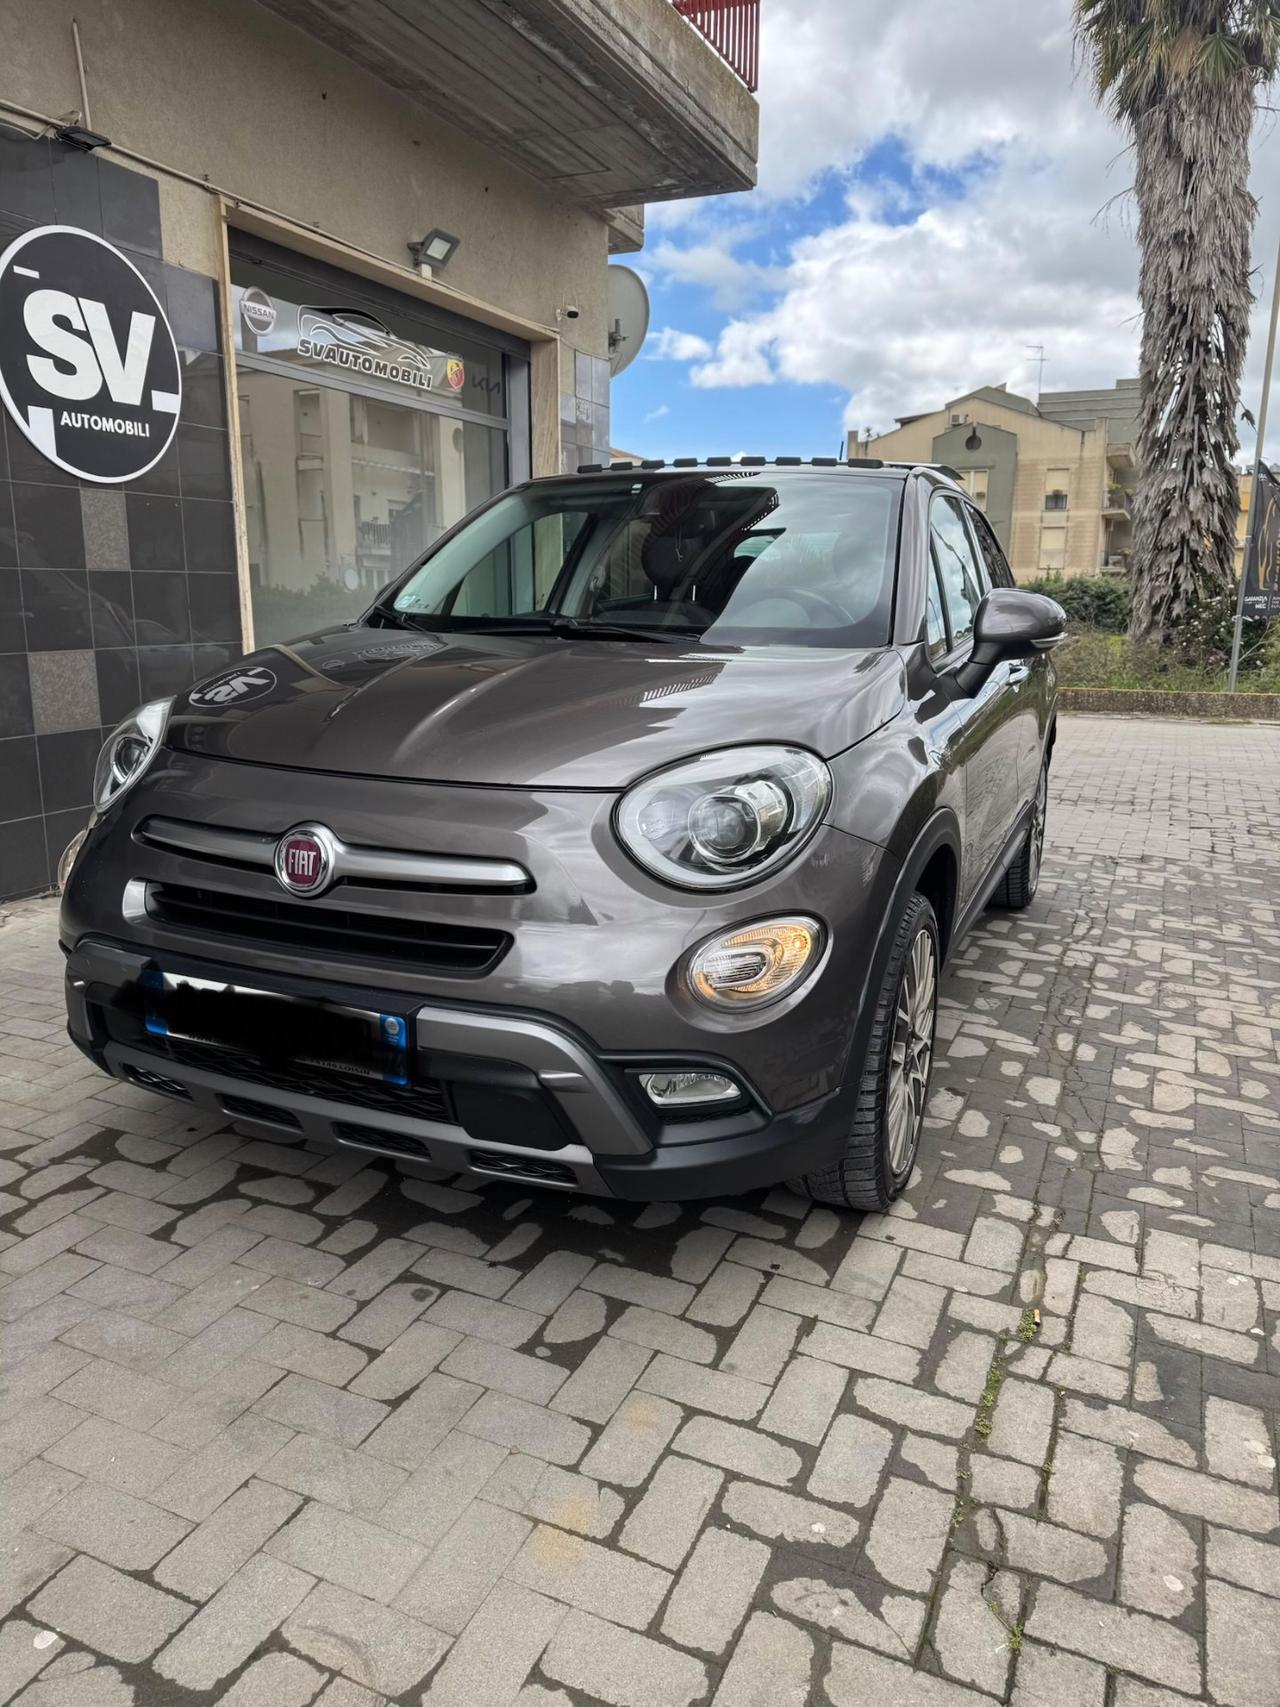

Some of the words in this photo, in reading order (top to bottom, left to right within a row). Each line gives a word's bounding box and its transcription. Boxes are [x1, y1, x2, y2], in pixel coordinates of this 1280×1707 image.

[242, 302, 275, 320] NISSAN
[23, 289, 156, 406] SV
[60, 411, 150, 437] AUTOMOBILI
[288, 848, 317, 876] FIAT
